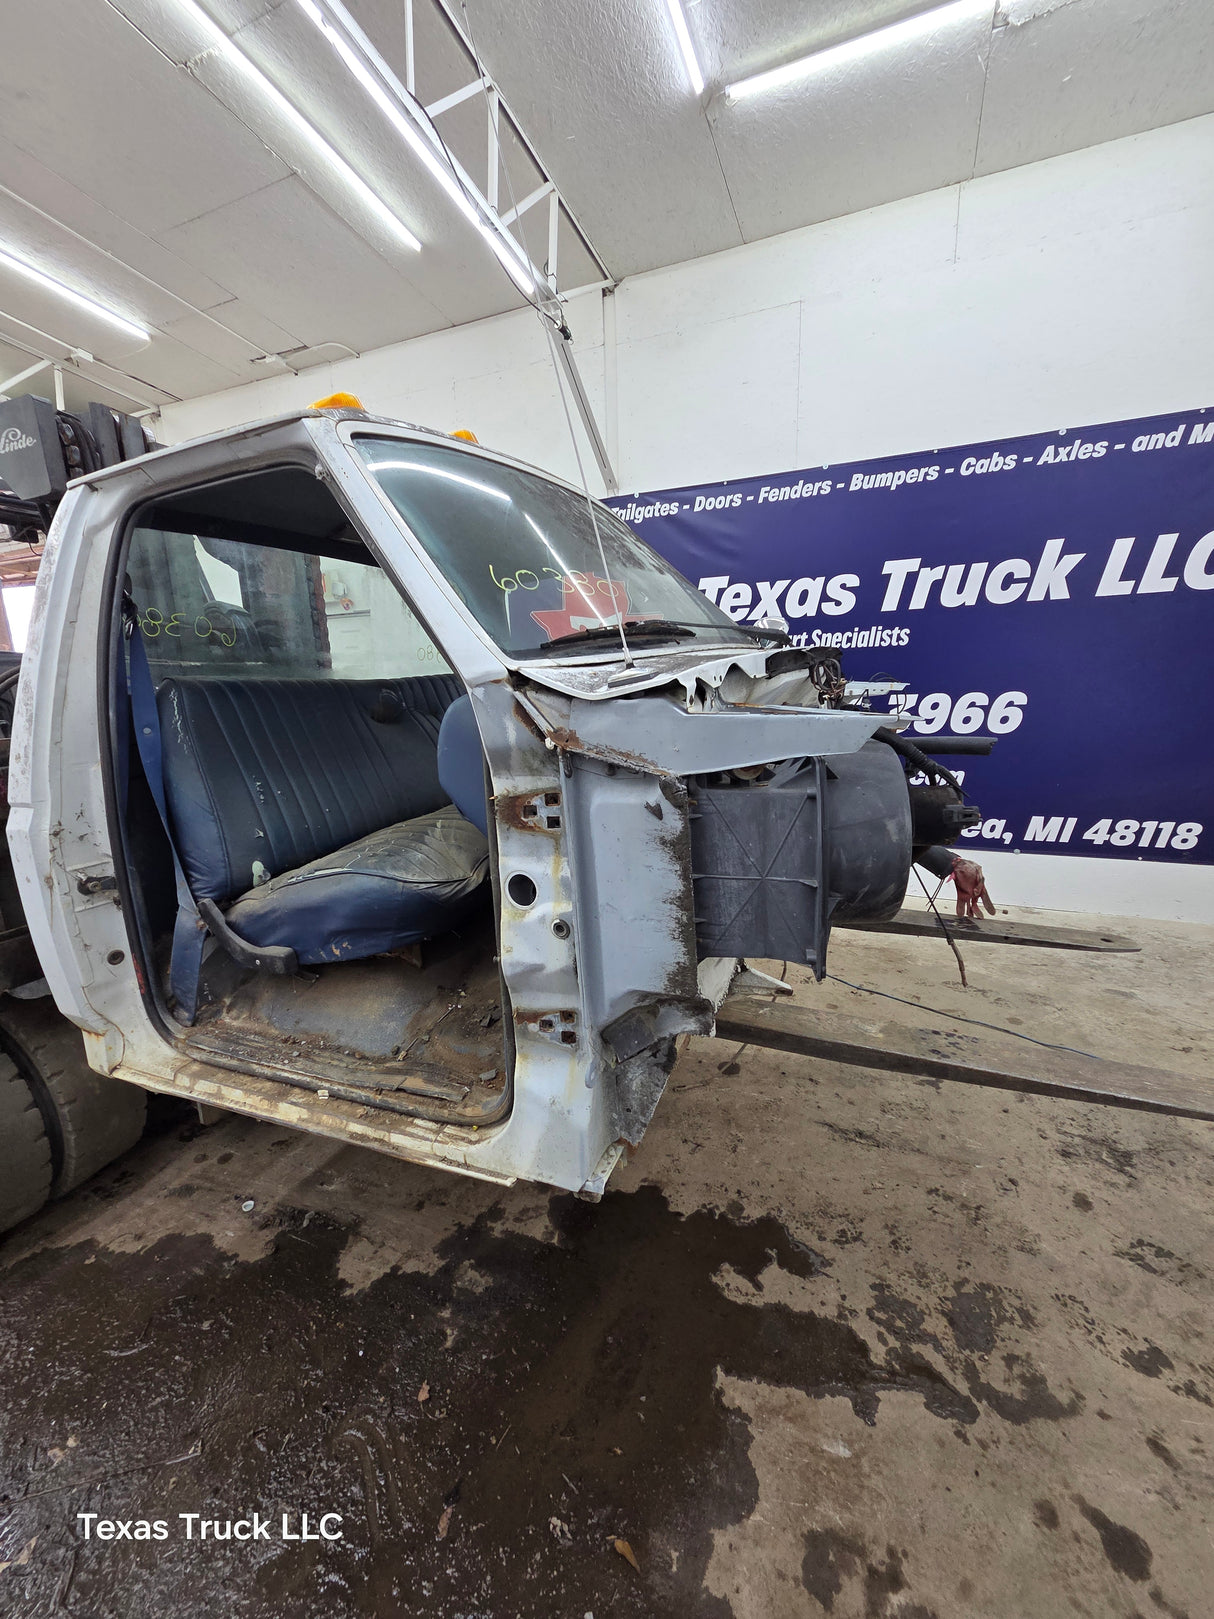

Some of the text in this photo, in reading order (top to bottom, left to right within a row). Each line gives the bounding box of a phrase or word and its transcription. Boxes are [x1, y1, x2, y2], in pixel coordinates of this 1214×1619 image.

[0, 427, 37, 454] Linde
[694, 493, 743, 513] Doors
[758, 480, 832, 504] Fenders
[849, 465, 941, 491] Bumpers
[960, 452, 1018, 476] Cabs
[1036, 440, 1109, 466] Axles
[1131, 424, 1187, 452] and
[698, 530, 1214, 623] Texas Truck LLC
[1023, 815, 1078, 843] MI
[1082, 818, 1204, 850] 48118
